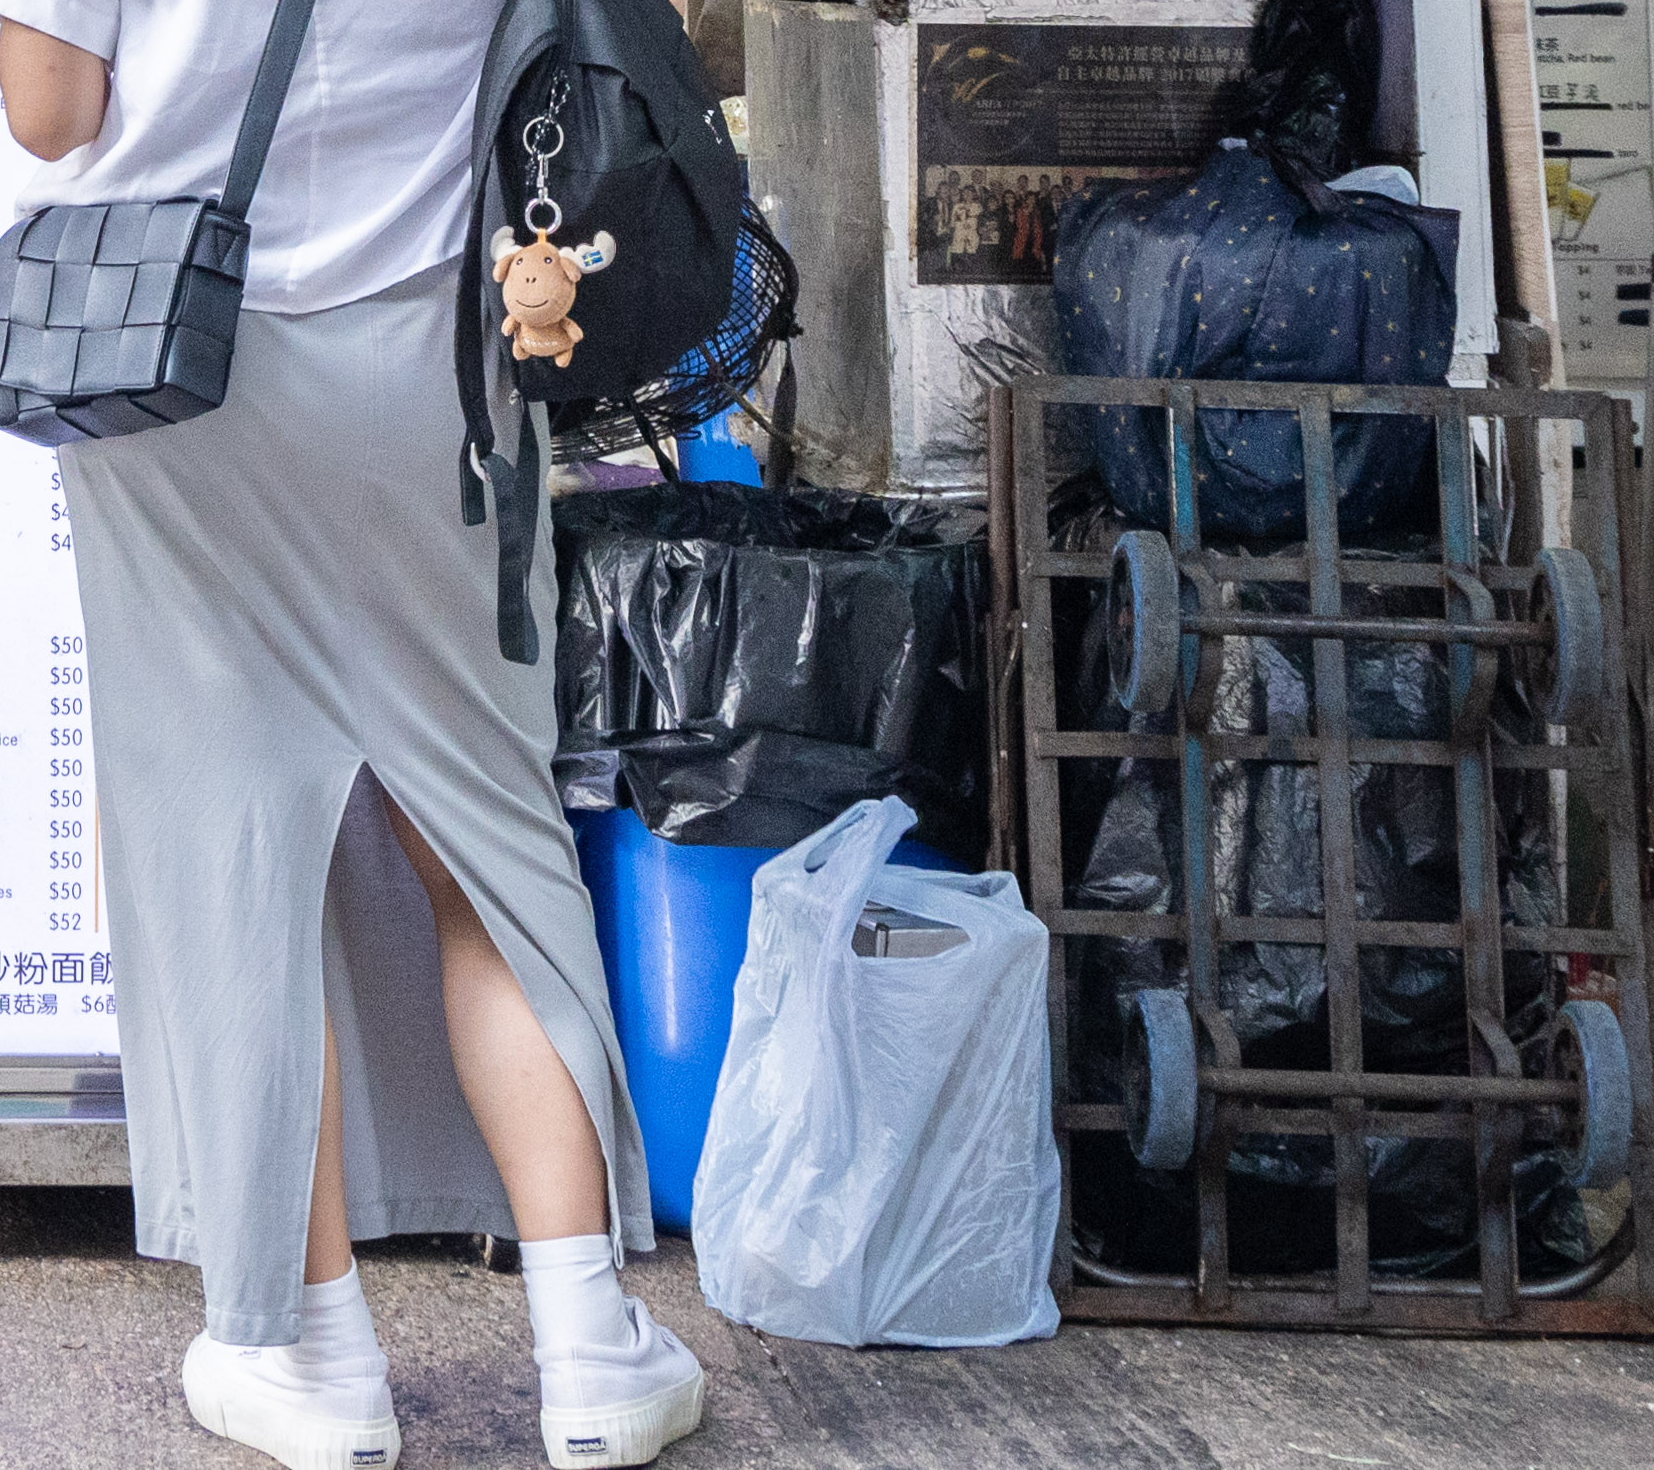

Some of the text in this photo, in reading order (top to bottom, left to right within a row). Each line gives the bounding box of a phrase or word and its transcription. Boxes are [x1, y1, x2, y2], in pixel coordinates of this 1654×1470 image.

[51, 636, 83, 655] $50
[49, 852, 82, 869] $50
[49, 913, 81, 931] $52
